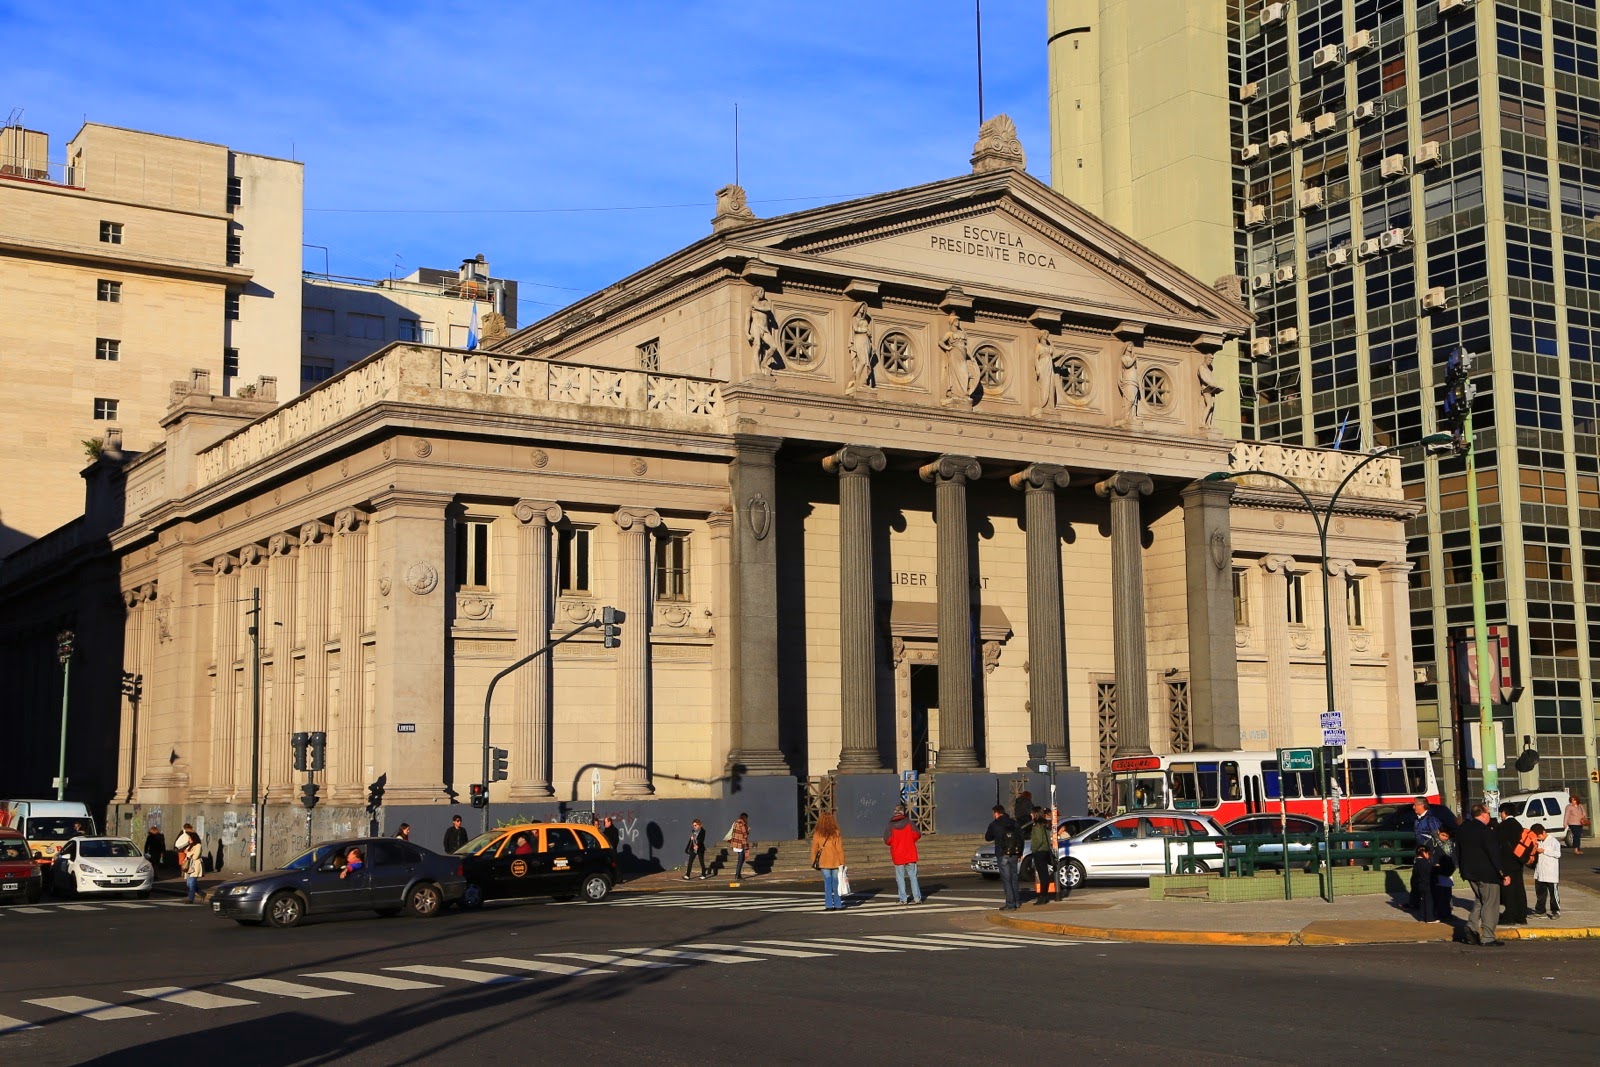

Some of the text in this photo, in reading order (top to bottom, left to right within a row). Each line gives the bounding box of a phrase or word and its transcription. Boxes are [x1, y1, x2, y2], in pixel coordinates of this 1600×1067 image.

[963, 225, 1024, 249] ESCVELA
[930, 235, 1056, 270] PRESIDENTE ROCA
[889, 572, 927, 586] LIBER
